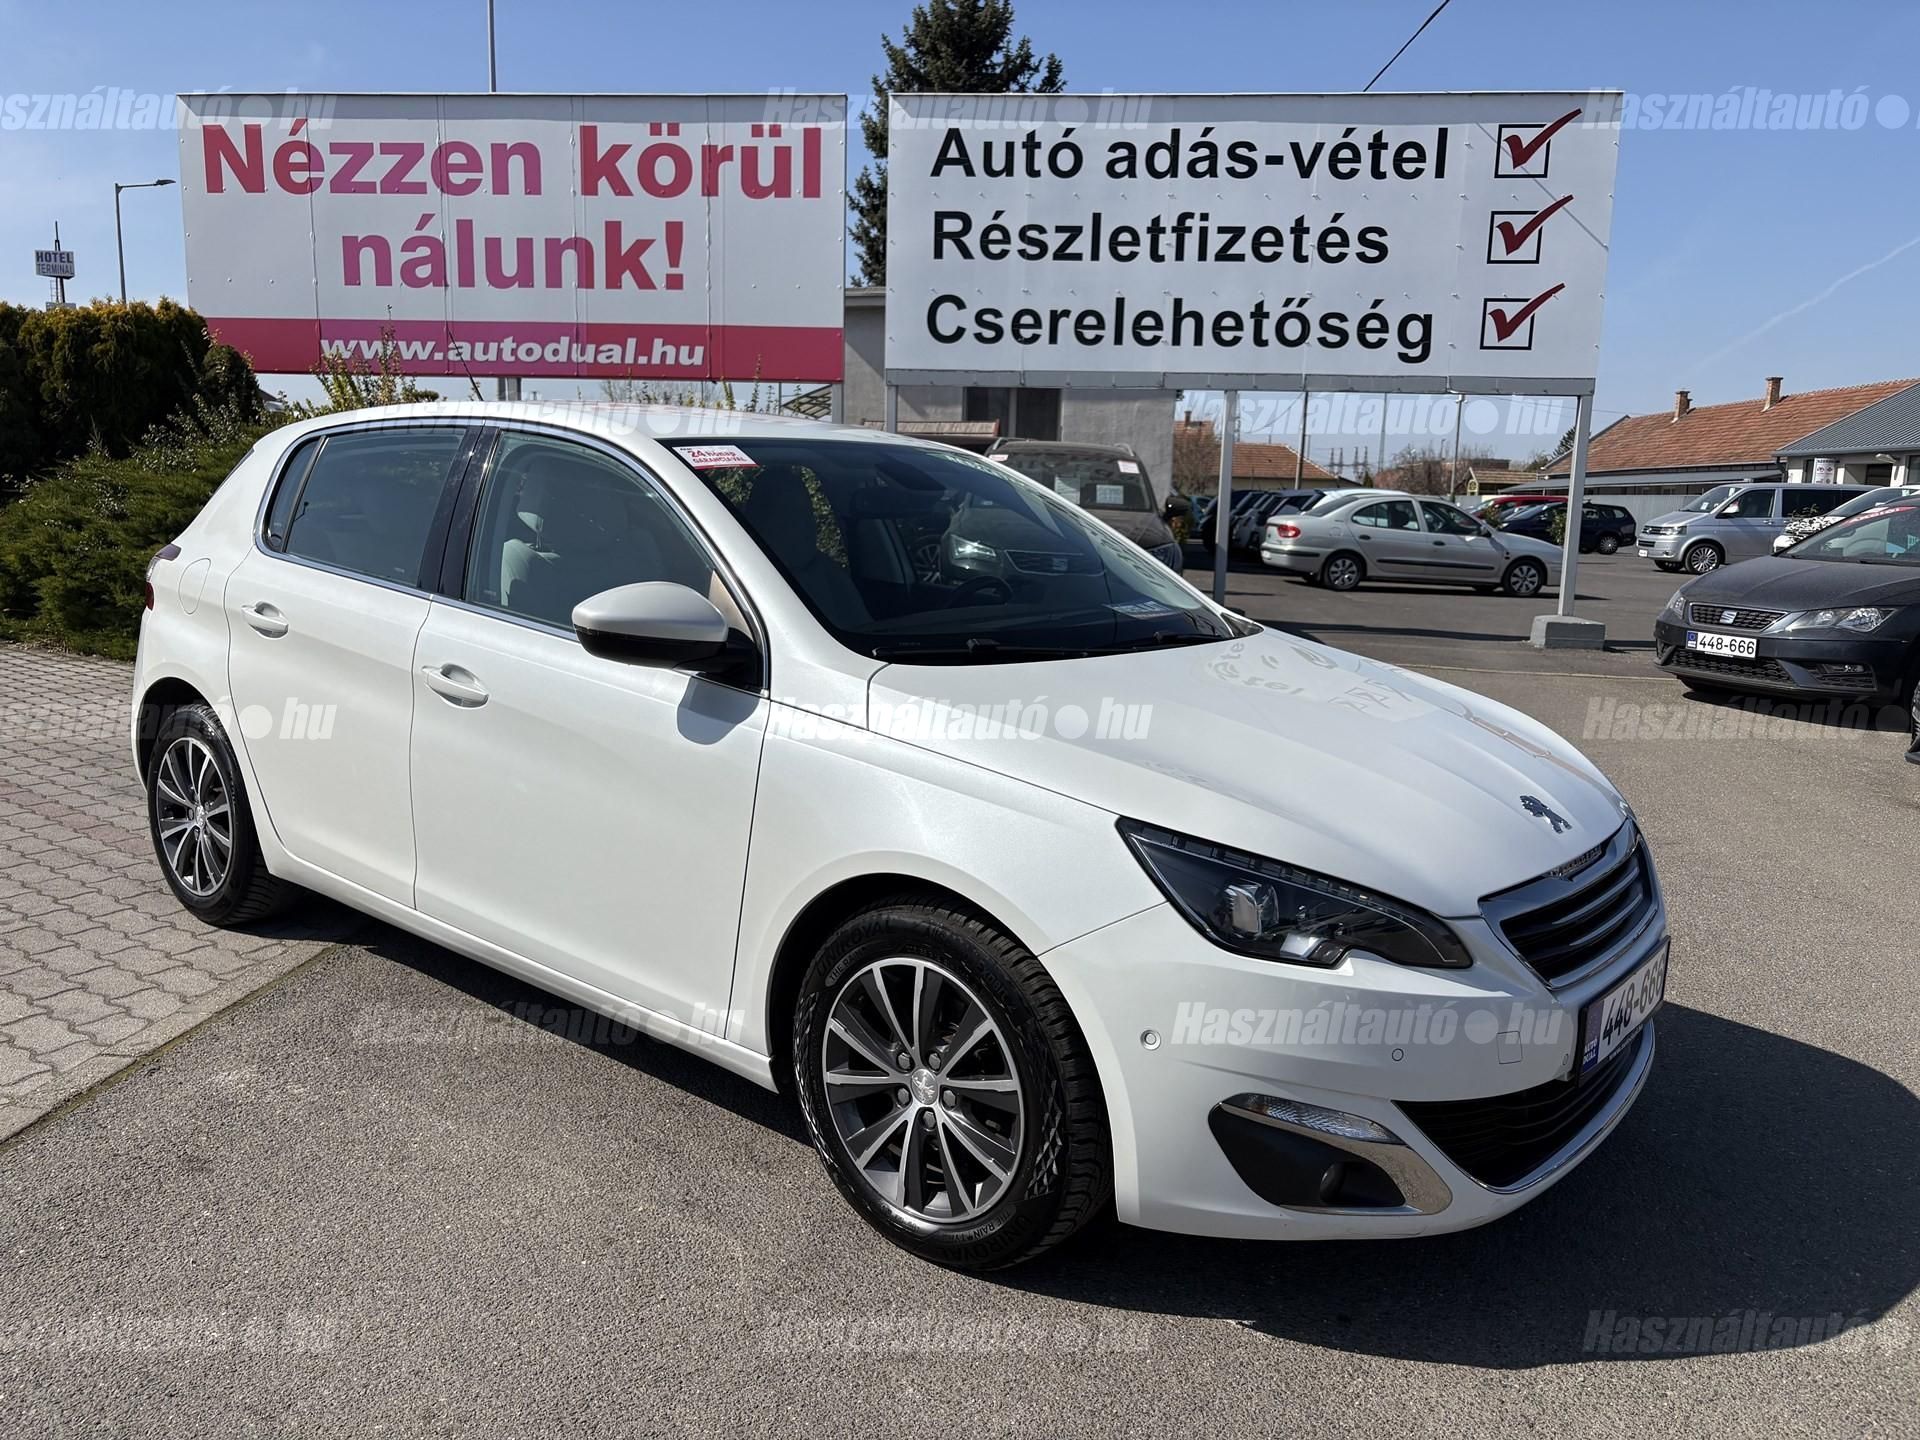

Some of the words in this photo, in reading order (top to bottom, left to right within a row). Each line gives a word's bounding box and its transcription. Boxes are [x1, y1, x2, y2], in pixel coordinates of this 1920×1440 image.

[203, 117, 541, 196] Nézzen
[580, 121, 821, 199] körül
[930, 126, 1084, 179] Autó
[1105, 126, 1449, 180] adás-vétel
[36, 251, 73, 263] HOTEL
[342, 217, 684, 291] nálunk!
[932, 210, 1390, 264] Részletfizetés
[36, 263, 75, 275] TERMINAL
[320, 336, 705, 366] www.autodual.hu
[926, 294, 1434, 364] Cserelehetőség
[1699, 634, 1755, 655] 448-666
[1602, 953, 1666, 1046] 448-666
